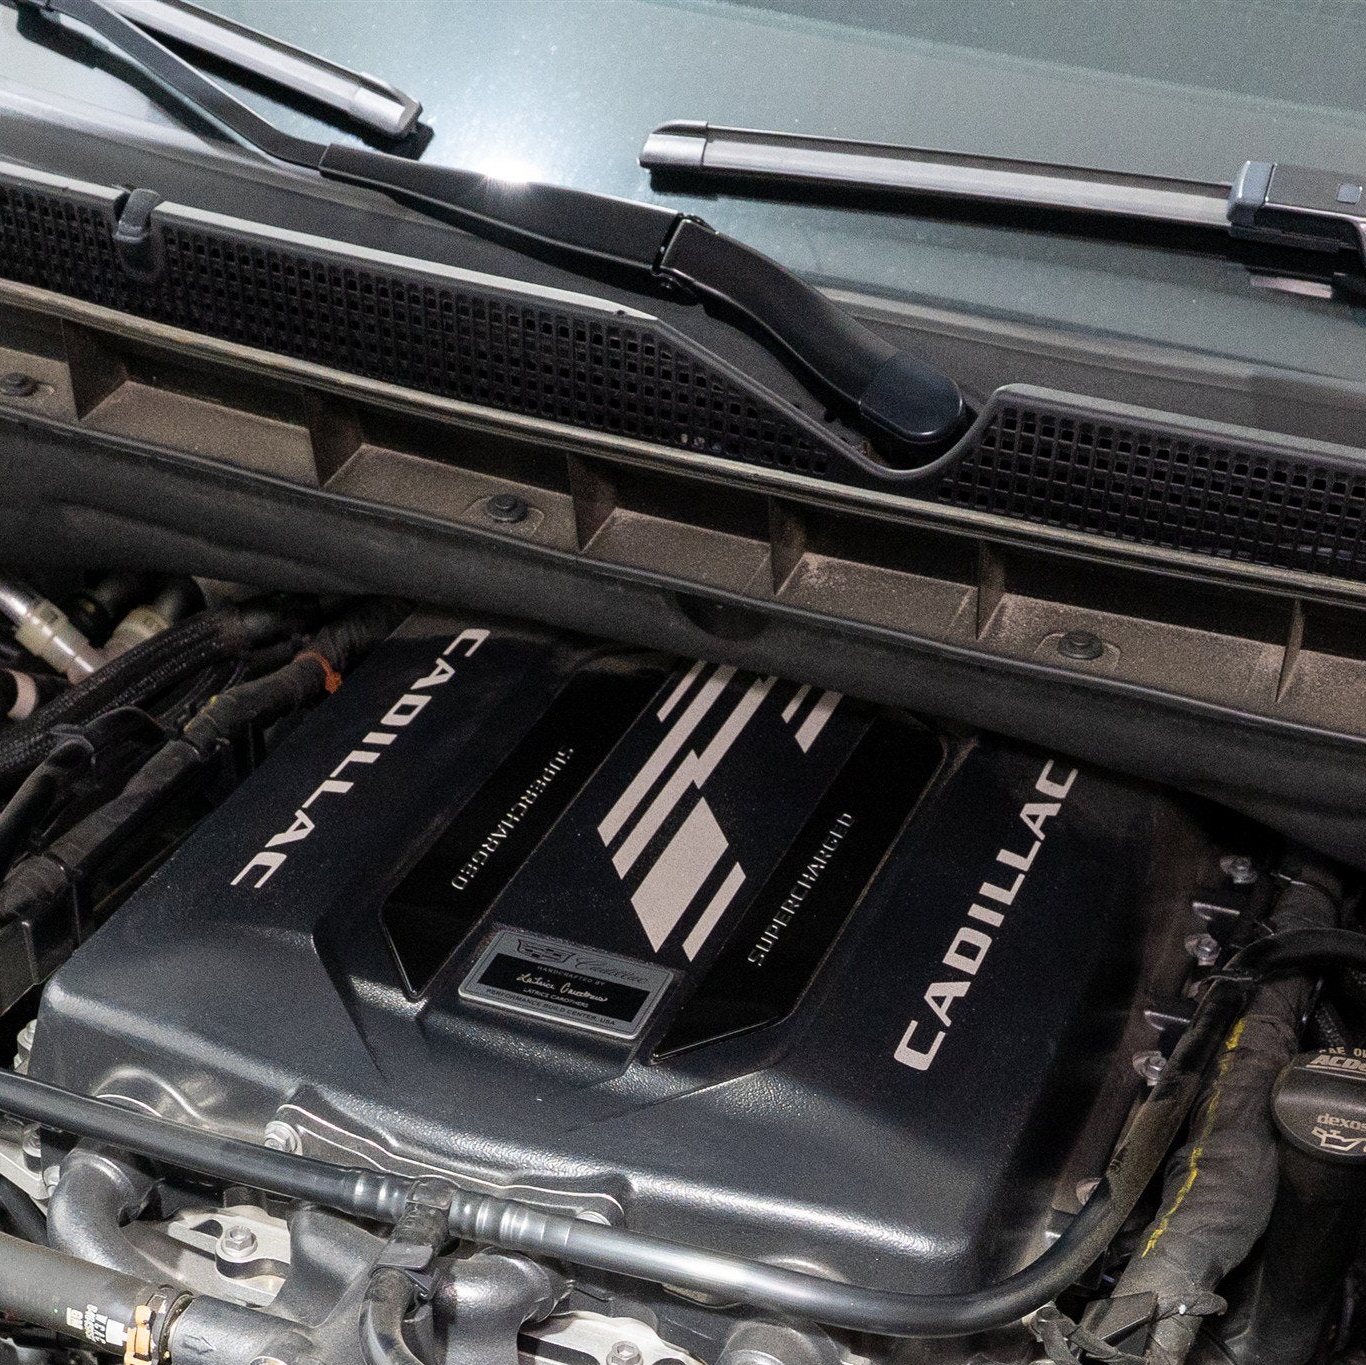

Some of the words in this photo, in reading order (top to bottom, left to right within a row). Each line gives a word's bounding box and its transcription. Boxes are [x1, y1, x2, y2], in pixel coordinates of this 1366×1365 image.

[230, 628, 488, 889] CADILLAC
[451, 745, 576, 892] SUPERCHARGED
[748, 810, 854, 966] SUPERCHARGED
[894, 758, 1080, 1072] CADILLAC
[485, 988, 543, 1008] PERFORMANCE
[543, 1003, 568, 1014] BUILD
[599, 1017, 616, 1026] USA
[522, 987, 550, 999] LATRICE
[549, 994, 589, 1009] CAROTHERS
[536, 965, 593, 984] HANDCRAFTED
[595, 977, 606, 987] BY
